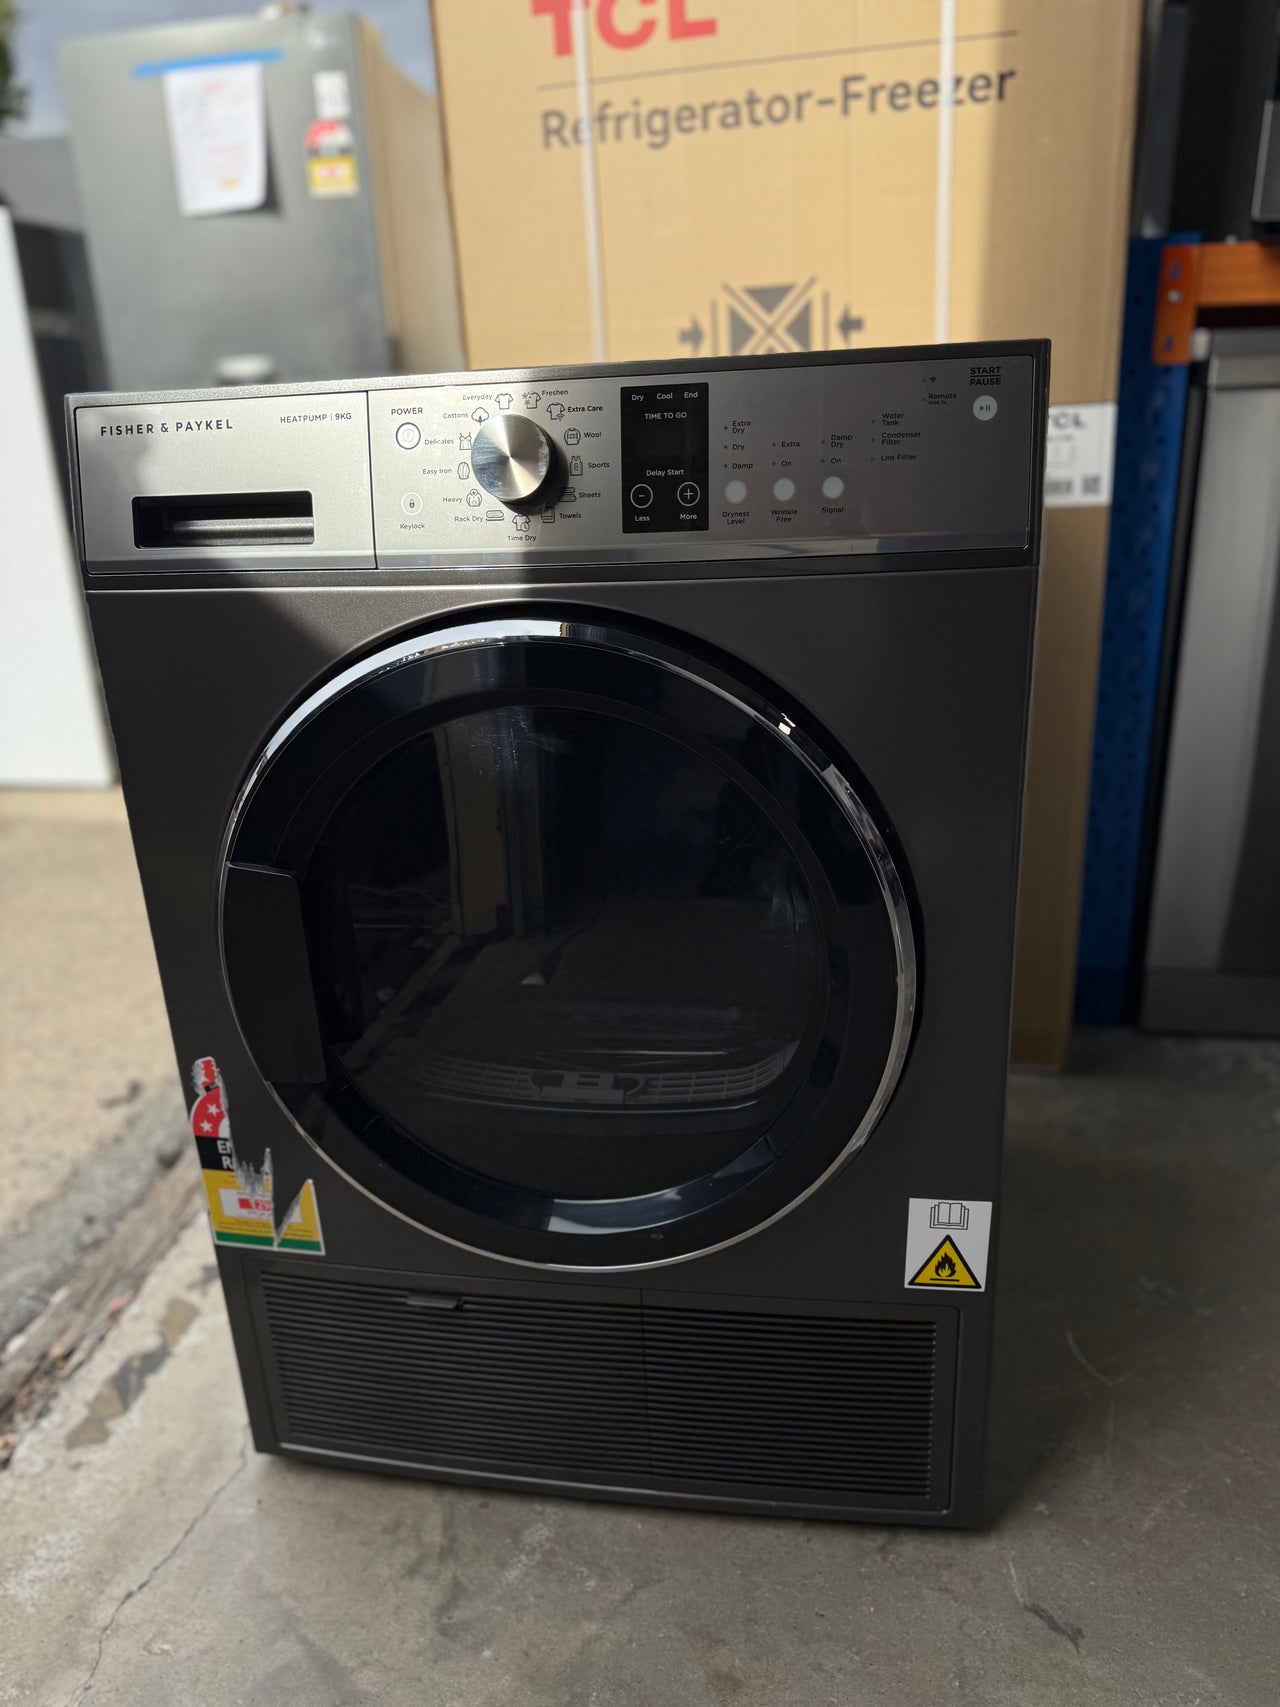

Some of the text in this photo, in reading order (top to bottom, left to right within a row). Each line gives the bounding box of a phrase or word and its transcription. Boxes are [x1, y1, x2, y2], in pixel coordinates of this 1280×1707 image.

[531, 0, 718, 58] TCL
[541, 68, 1018, 150] Refrigerator-Freezer
[970, 367, 1002, 375] START
[970, 378, 1002, 386] PAUSE
[541, 388, 569, 396] Freshen
[656, 392, 673, 400] Cool
[683, 391, 698, 399] End
[462, 392, 493, 401] Everyday
[631, 394, 645, 402] Dry
[390, 407, 424, 415] POWER
[587, 404, 604, 412] Care
[279, 412, 352, 424] HEATPUMP 9KG
[442, 411, 469, 419] Cottons
[675, 411, 687, 419] GO
[882, 412, 904, 420] Water
[100, 419, 233, 436] FISHER & PAYKEL
[732, 427, 745, 435] Dry
[881, 431, 921, 439] Condenser
[830, 441, 844, 449] Dry
[881, 438, 901, 446] Filter
[732, 443, 745, 451] Dry
[881, 453, 917, 462] Lint Filter
[587, 461, 610, 469] Sports
[646, 468, 684, 477] Delay Start
[442, 496, 463, 504] Heavy
[770, 508, 798, 516] Wrinkle
[821, 506, 844, 514] Signal
[471, 515, 484, 523] Dry
[722, 511, 750, 519] Dryness
[776, 515, 792, 523] Free
[524, 535, 537, 543] Dry
